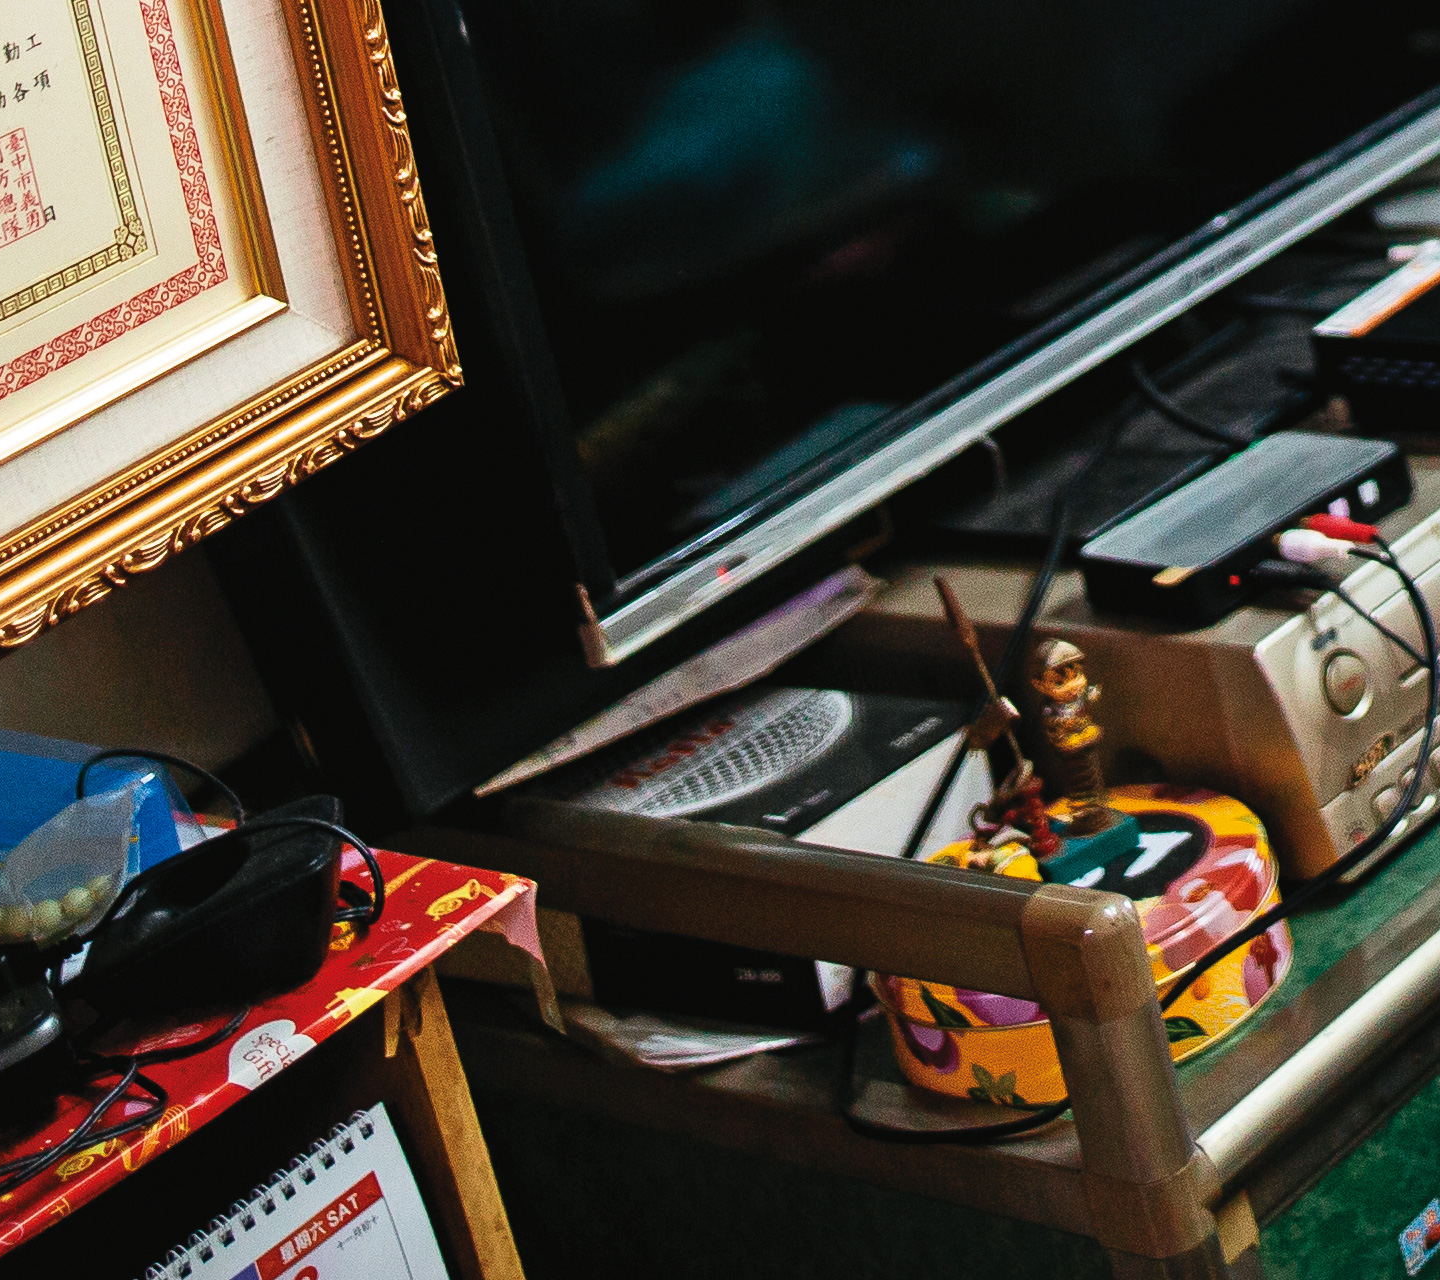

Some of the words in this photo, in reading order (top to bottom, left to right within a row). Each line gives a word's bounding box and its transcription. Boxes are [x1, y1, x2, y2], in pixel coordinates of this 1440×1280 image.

[278, 1220, 327, 1265] 星期六
[326, 1192, 360, 1228] SAT
